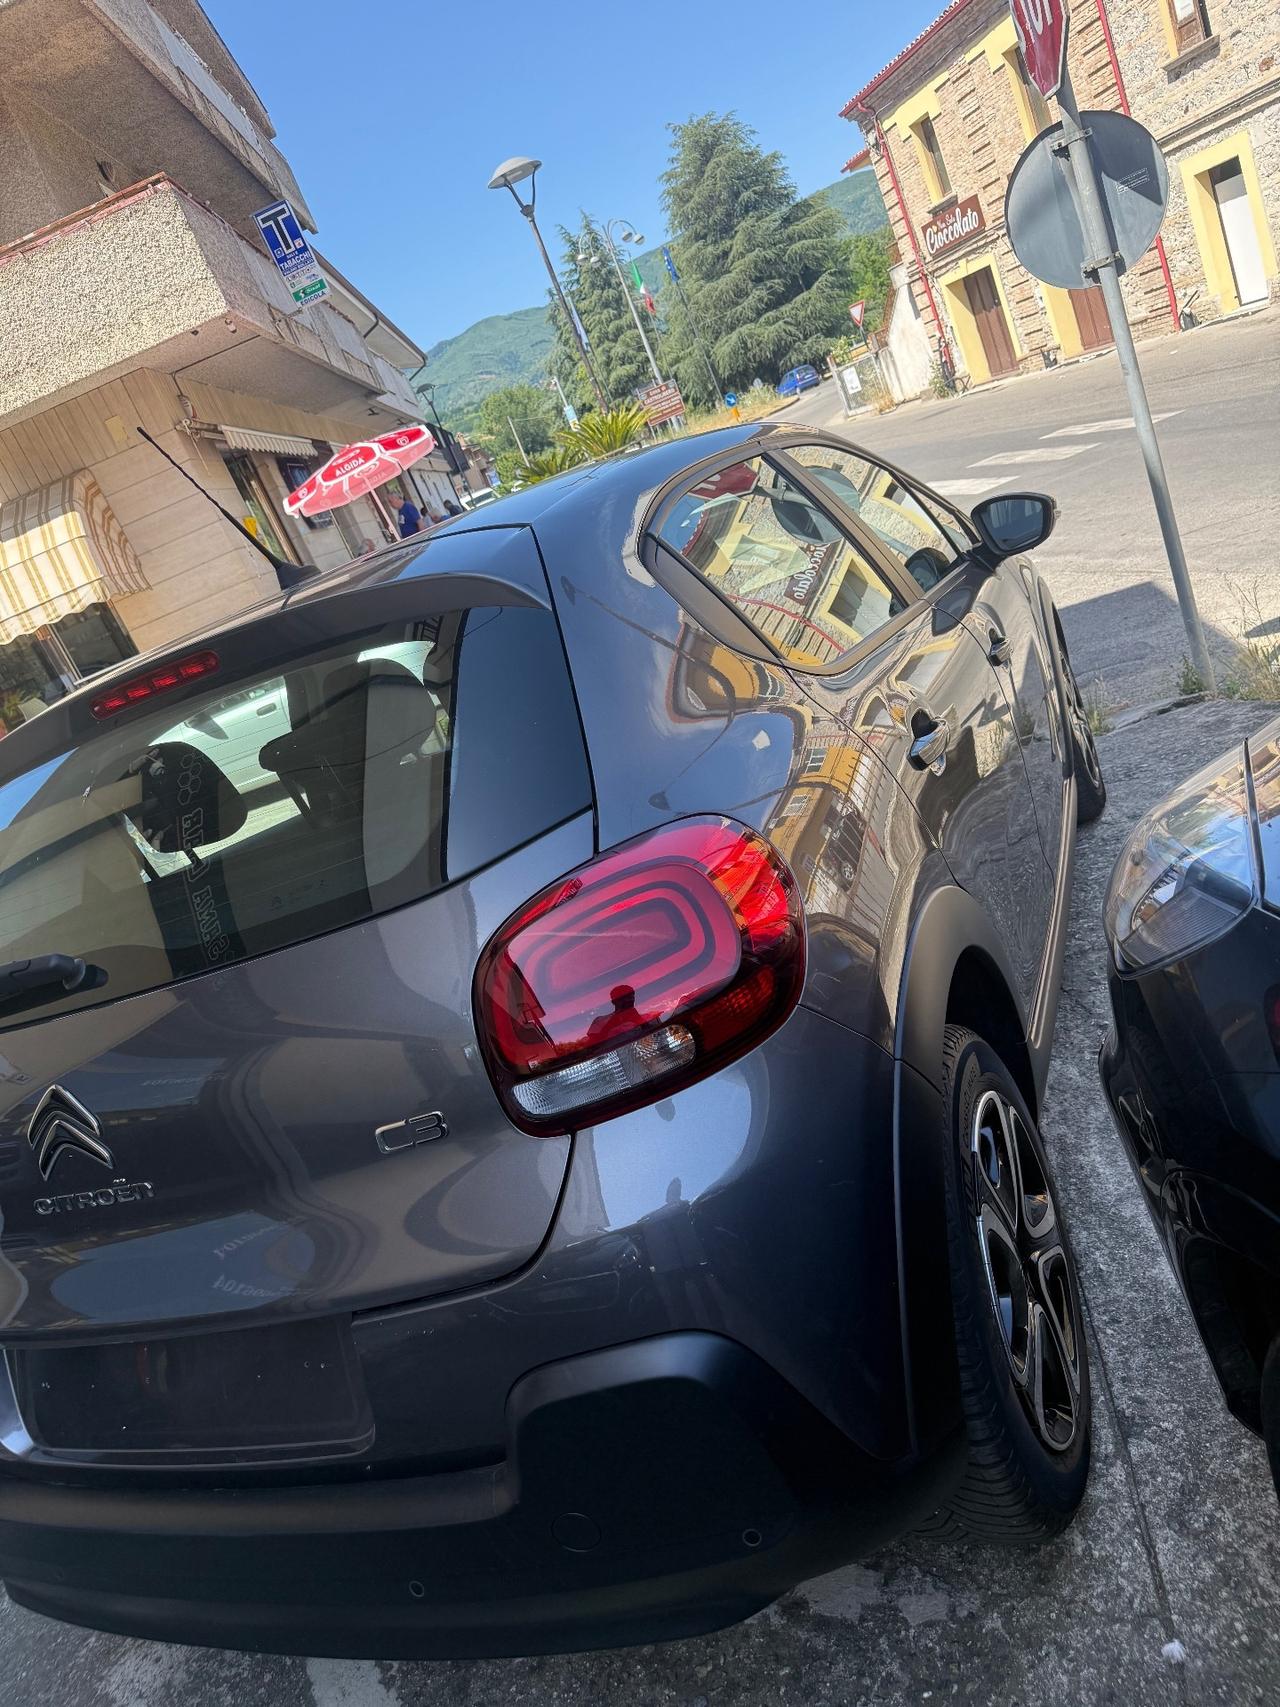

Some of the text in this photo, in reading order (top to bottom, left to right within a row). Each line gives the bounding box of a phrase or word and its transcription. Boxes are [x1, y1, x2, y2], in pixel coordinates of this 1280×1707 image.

[257, 203, 296, 255] T
[925, 207, 979, 254] Cioccolato
[279, 250, 313, 271] TABACCHI
[300, 290, 326, 307] EDICOLA
[335, 458, 365, 477] ALGIDA
[375, 1110, 448, 1154] C3
[33, 1178, 154, 1215] CITROËN
